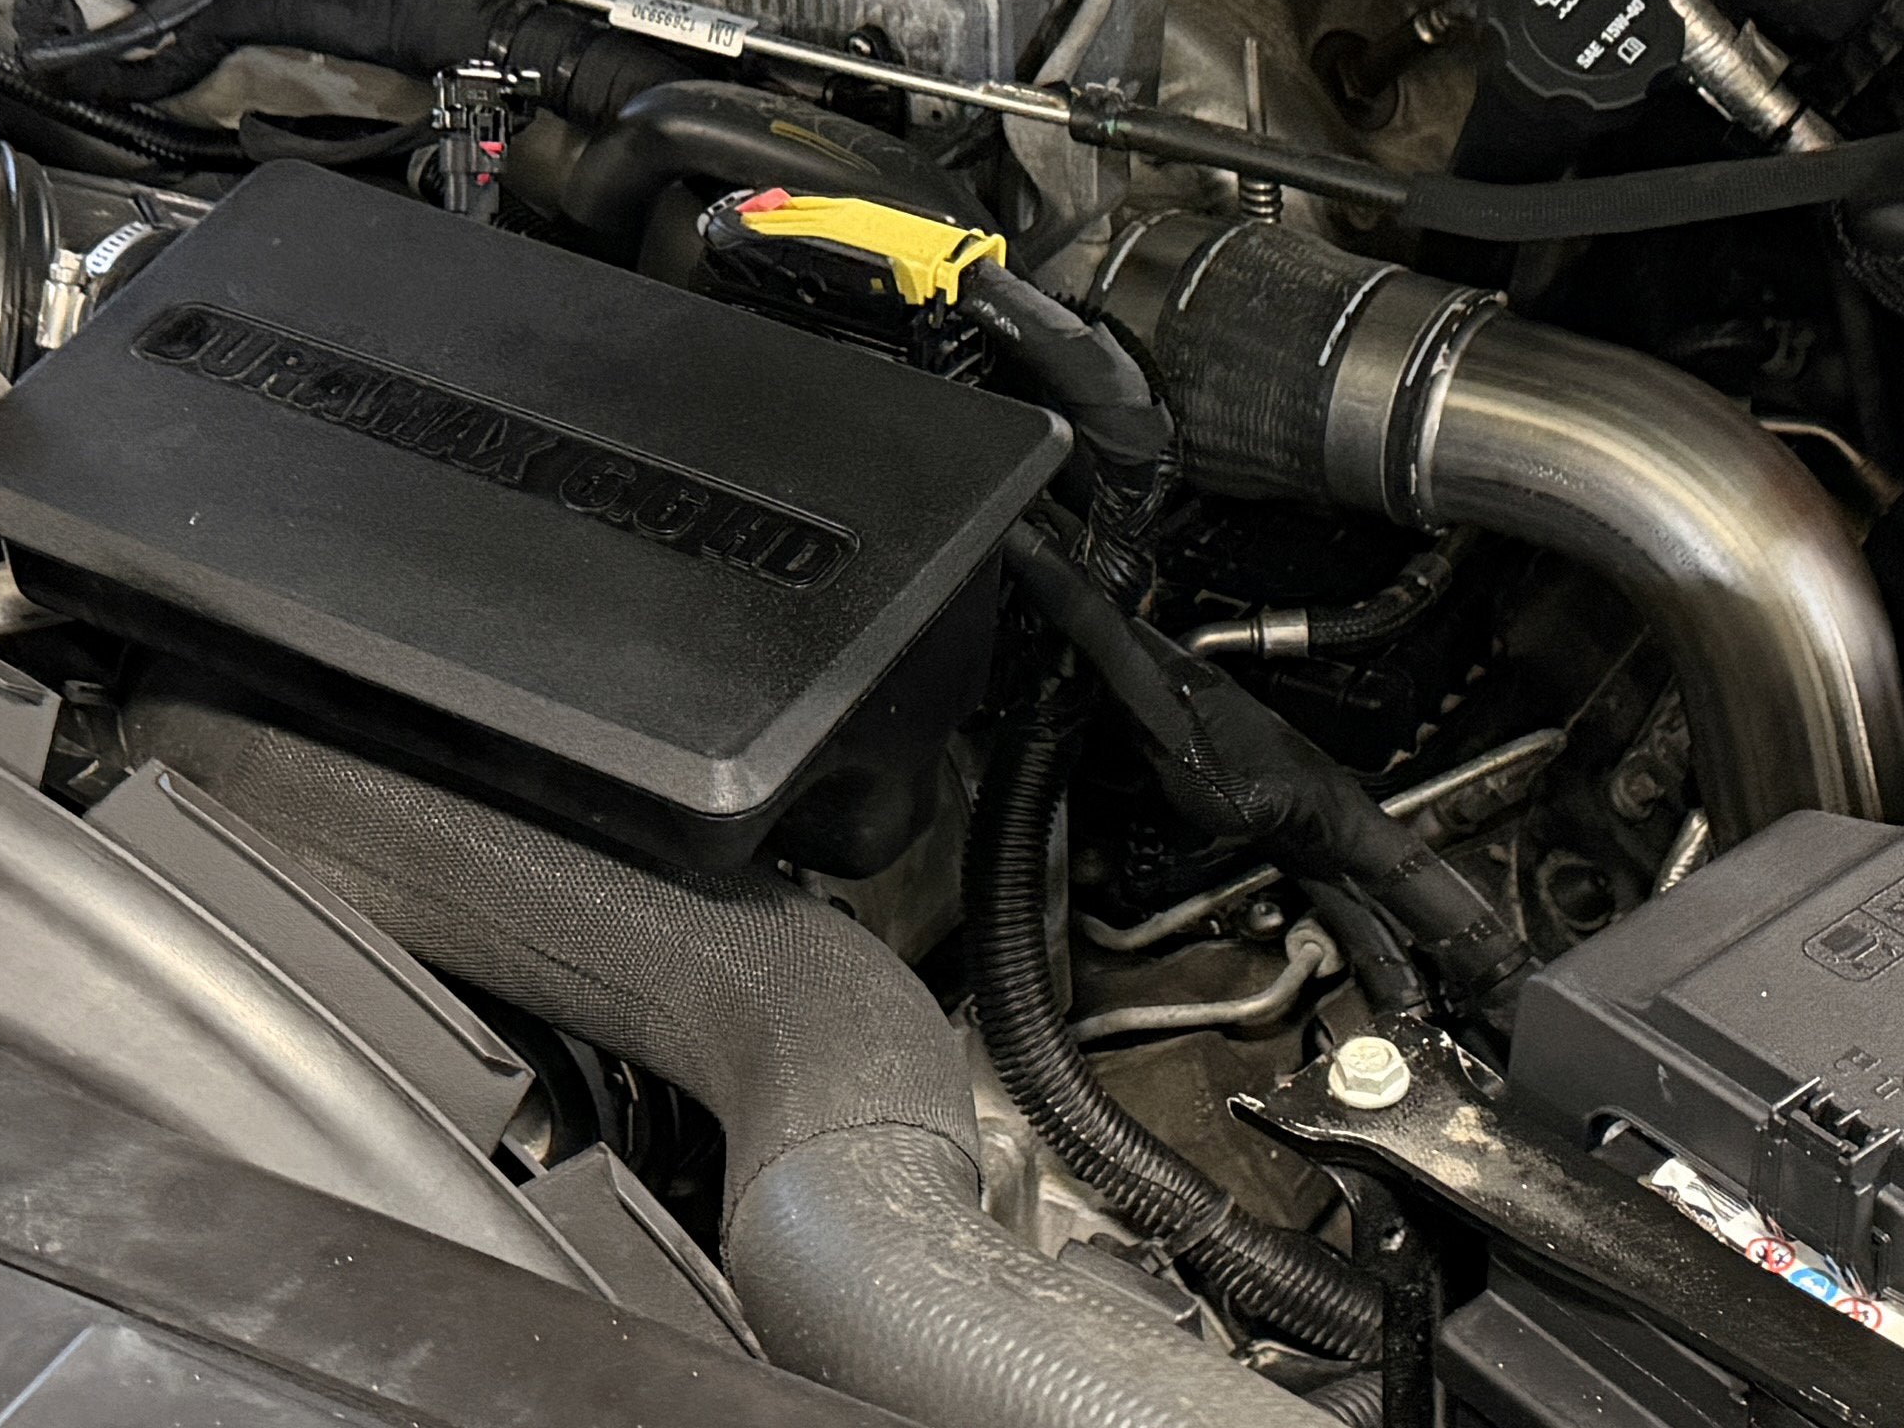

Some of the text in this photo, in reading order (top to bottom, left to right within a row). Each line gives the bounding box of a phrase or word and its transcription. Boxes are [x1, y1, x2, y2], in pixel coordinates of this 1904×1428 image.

[1576, 39, 1605, 70] SAE
[144, 306, 857, 588] DURAMAX 6.6 HD
